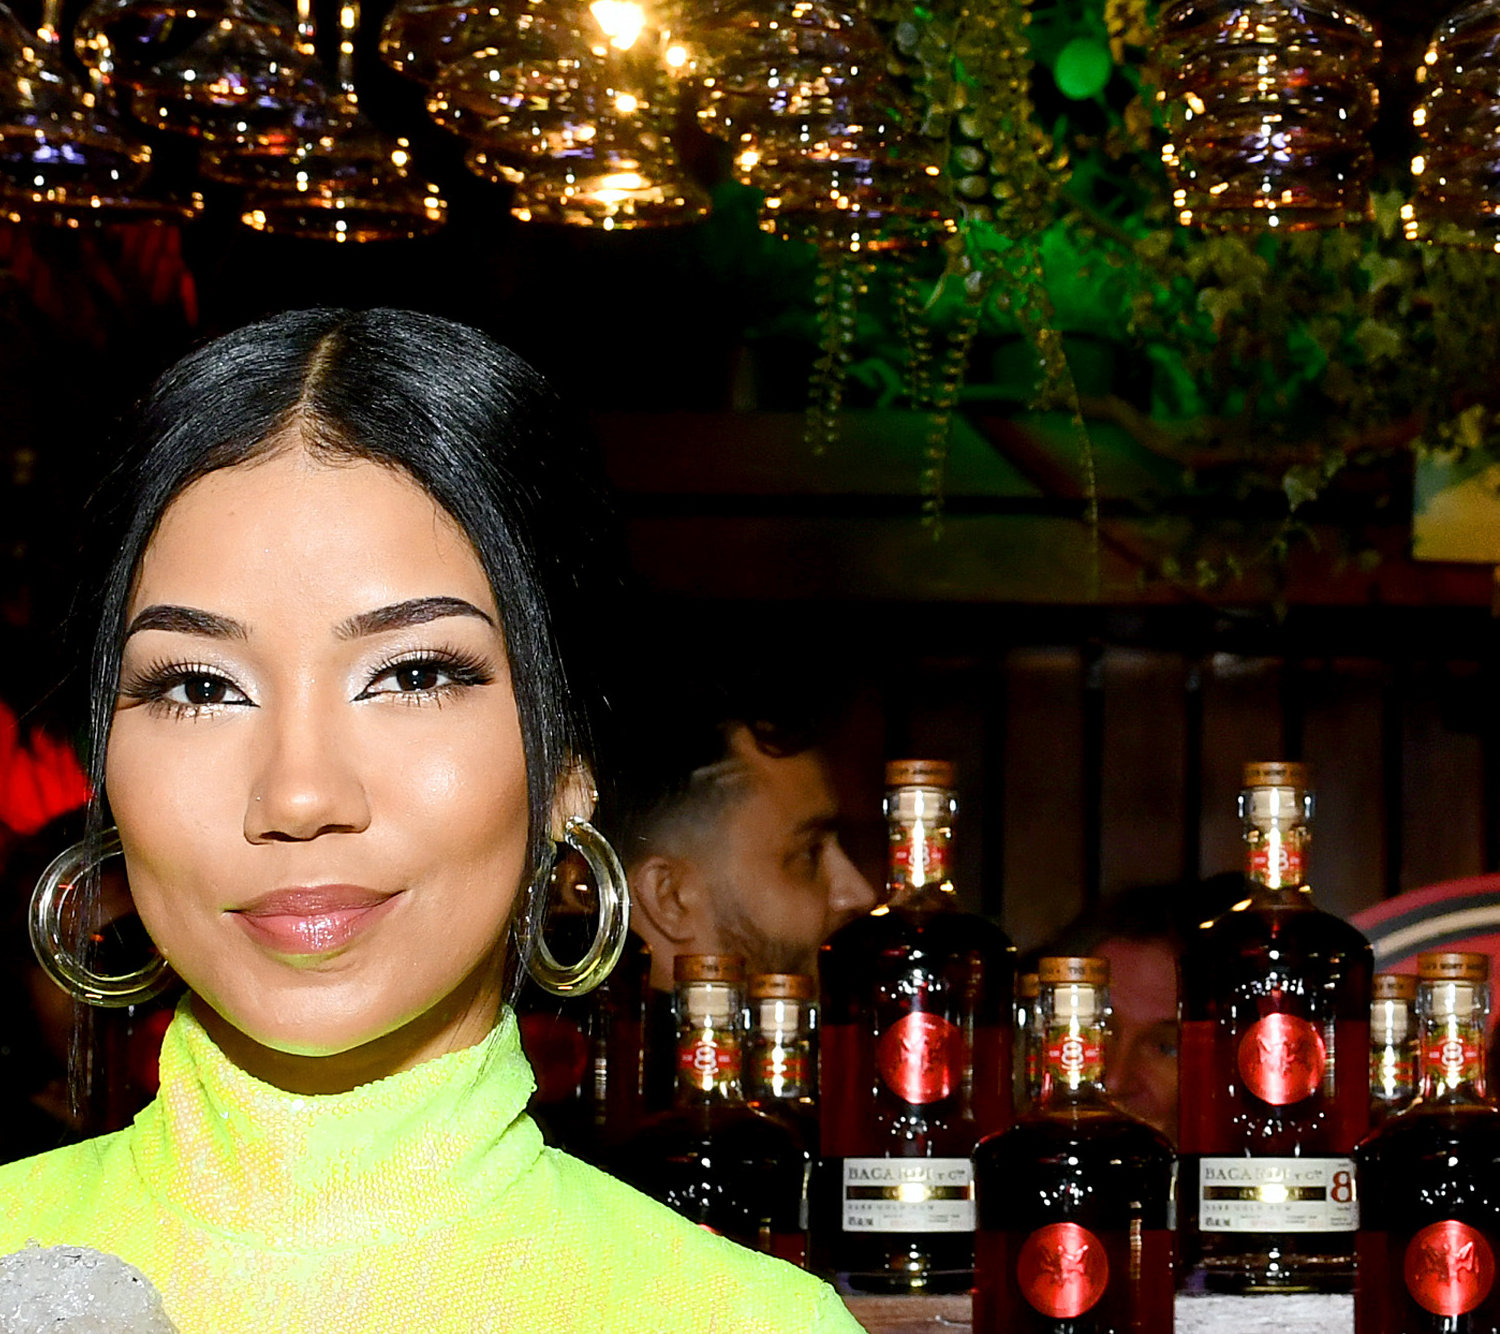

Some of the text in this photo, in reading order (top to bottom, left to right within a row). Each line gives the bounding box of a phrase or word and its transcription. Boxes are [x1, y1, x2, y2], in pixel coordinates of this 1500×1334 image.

[693, 1045, 717, 1070] 8
[1061, 1042, 1085, 1066] 8
[1441, 1041, 1465, 1066] 8
[1330, 1170, 1351, 1203] 8
